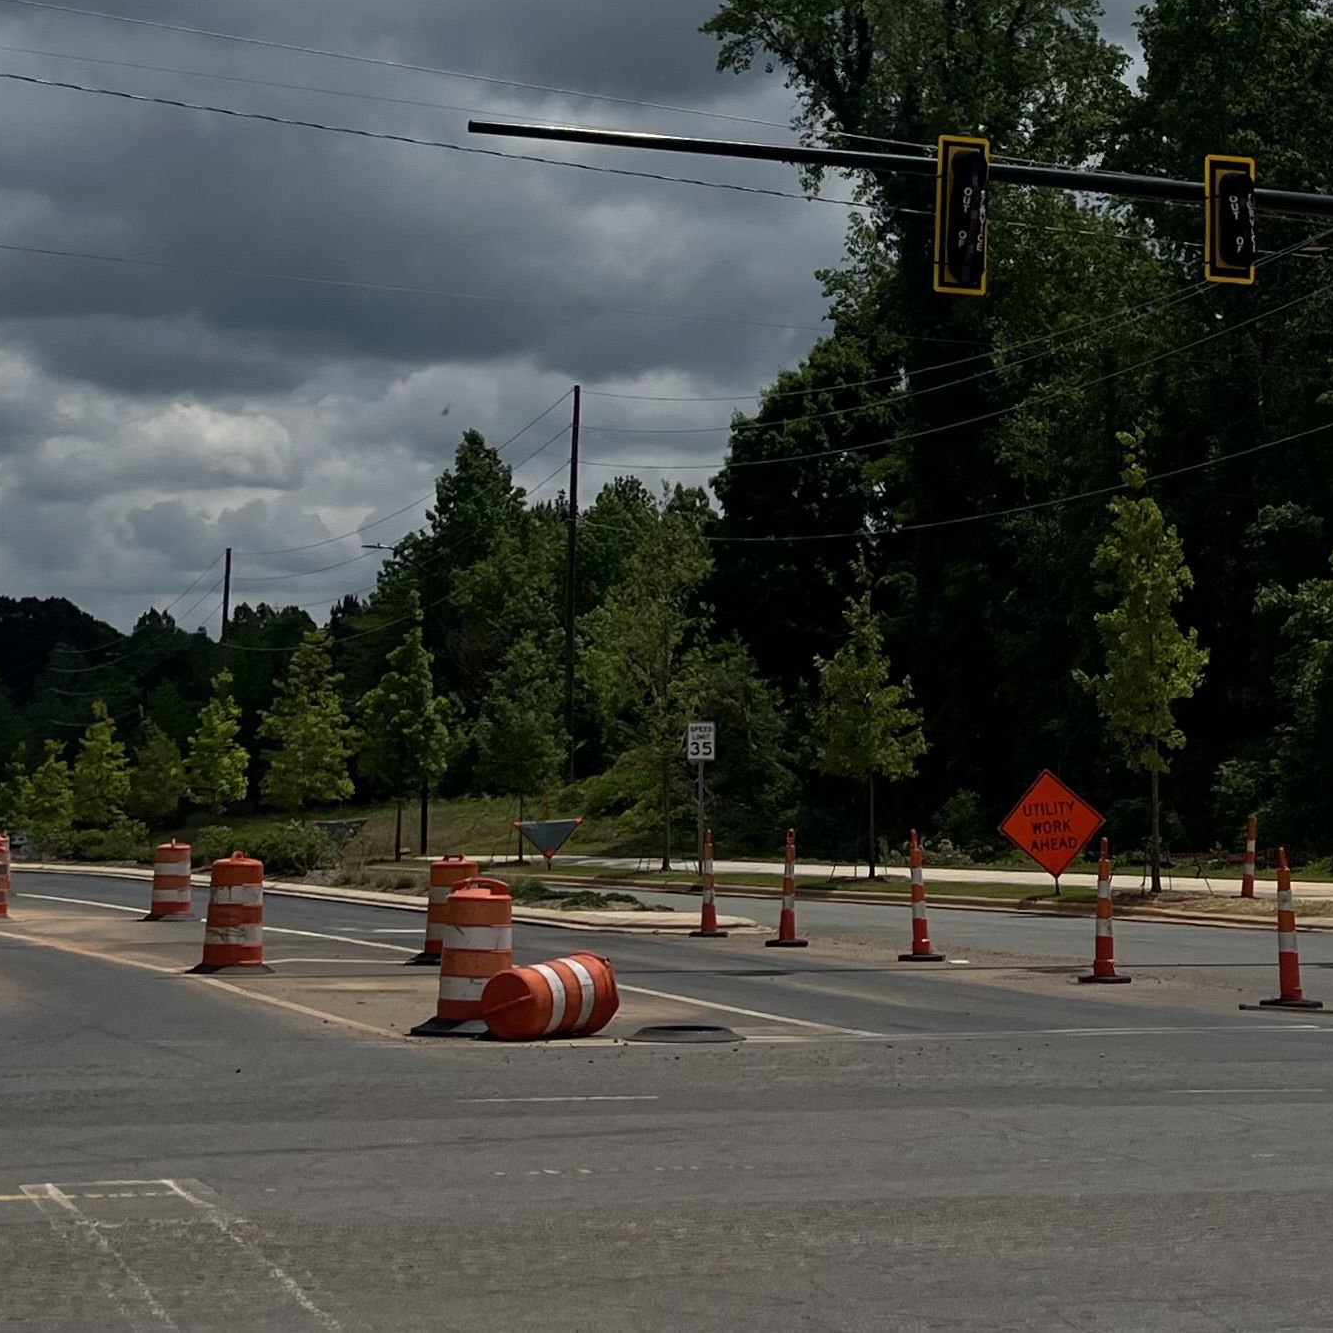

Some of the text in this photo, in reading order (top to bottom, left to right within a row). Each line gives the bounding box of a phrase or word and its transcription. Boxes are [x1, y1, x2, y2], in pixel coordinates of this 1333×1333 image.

[1228, 195, 1239, 221] OUT
[958, 186, 973, 249] OUT OF
[690, 741, 712, 756] 35
[1023, 800, 1075, 818] UTILITY
[1031, 819, 1072, 835] WORK
[1030, 836, 1078, 853] AHEAD
